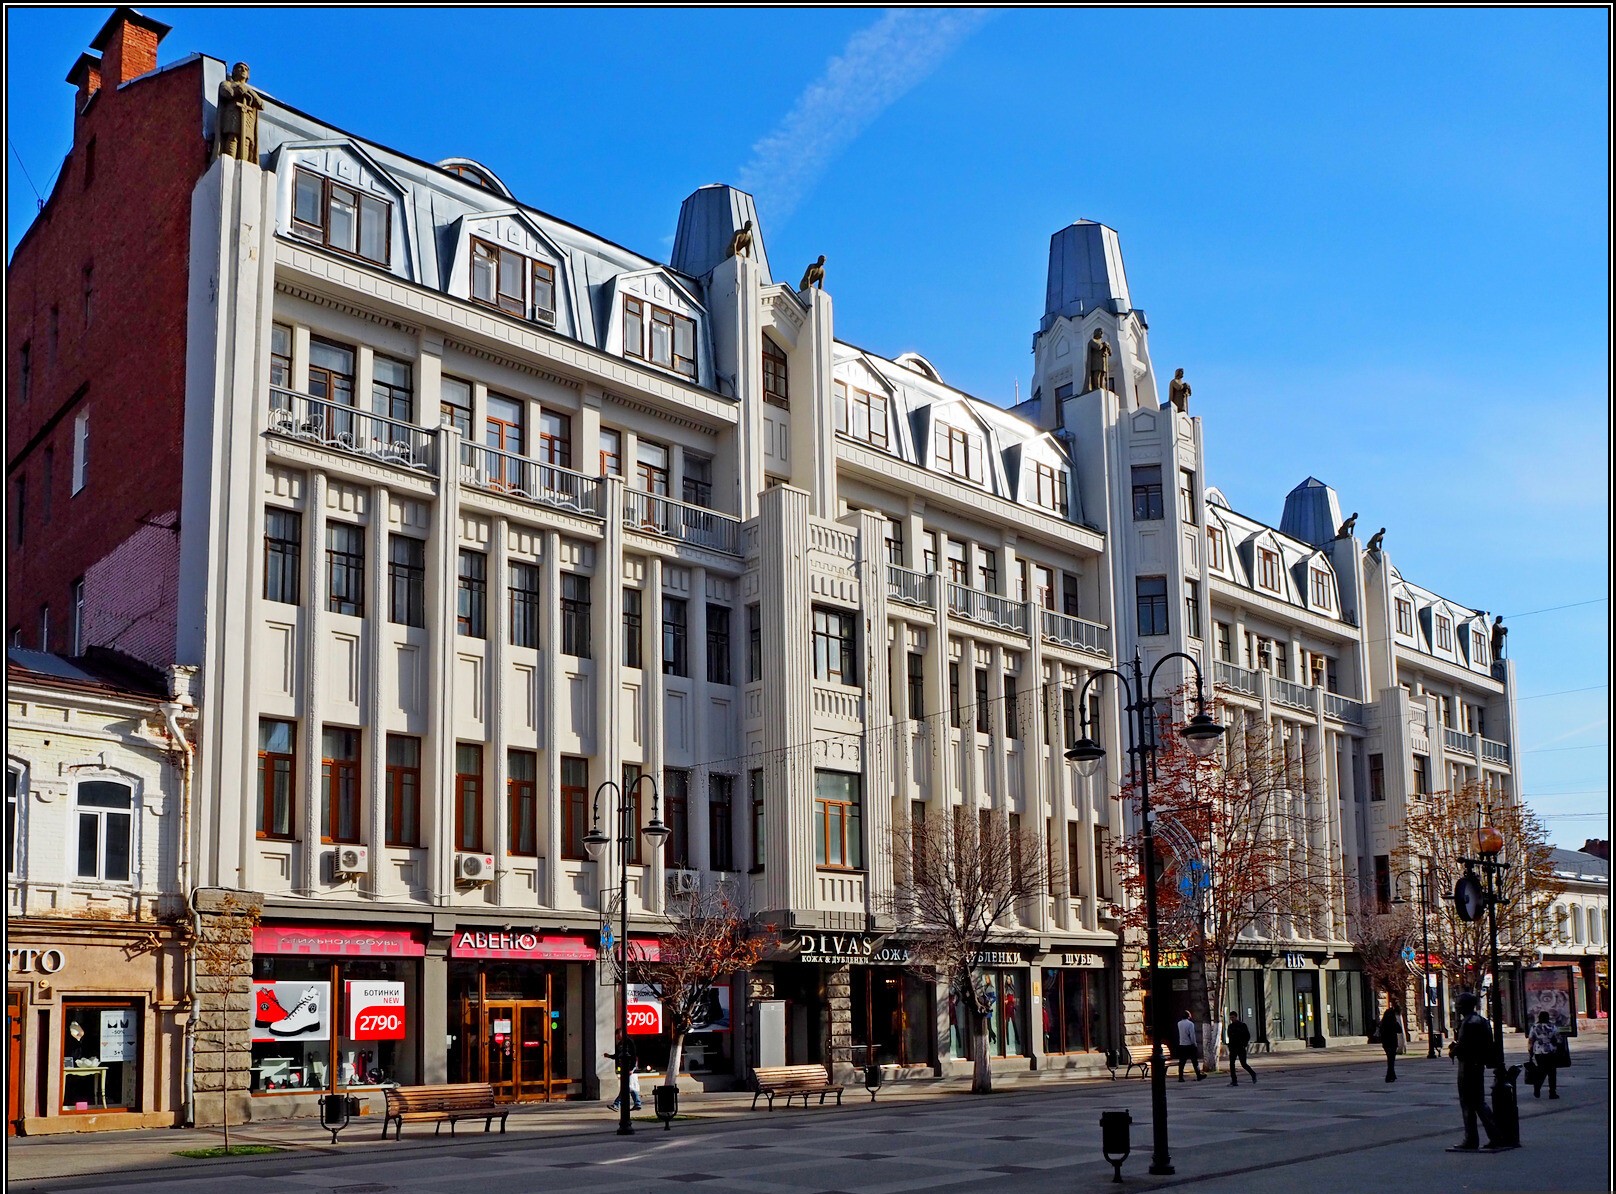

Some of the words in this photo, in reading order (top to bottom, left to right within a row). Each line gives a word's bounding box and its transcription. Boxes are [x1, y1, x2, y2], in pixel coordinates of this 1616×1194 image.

[458, 931, 537, 950] АВЕНЮ
[802, 955, 823, 963] КОЖА
[832, 956, 869, 964] ДУБЛЕНКИ
[1064, 953, 1094, 965] ШУБЫ
